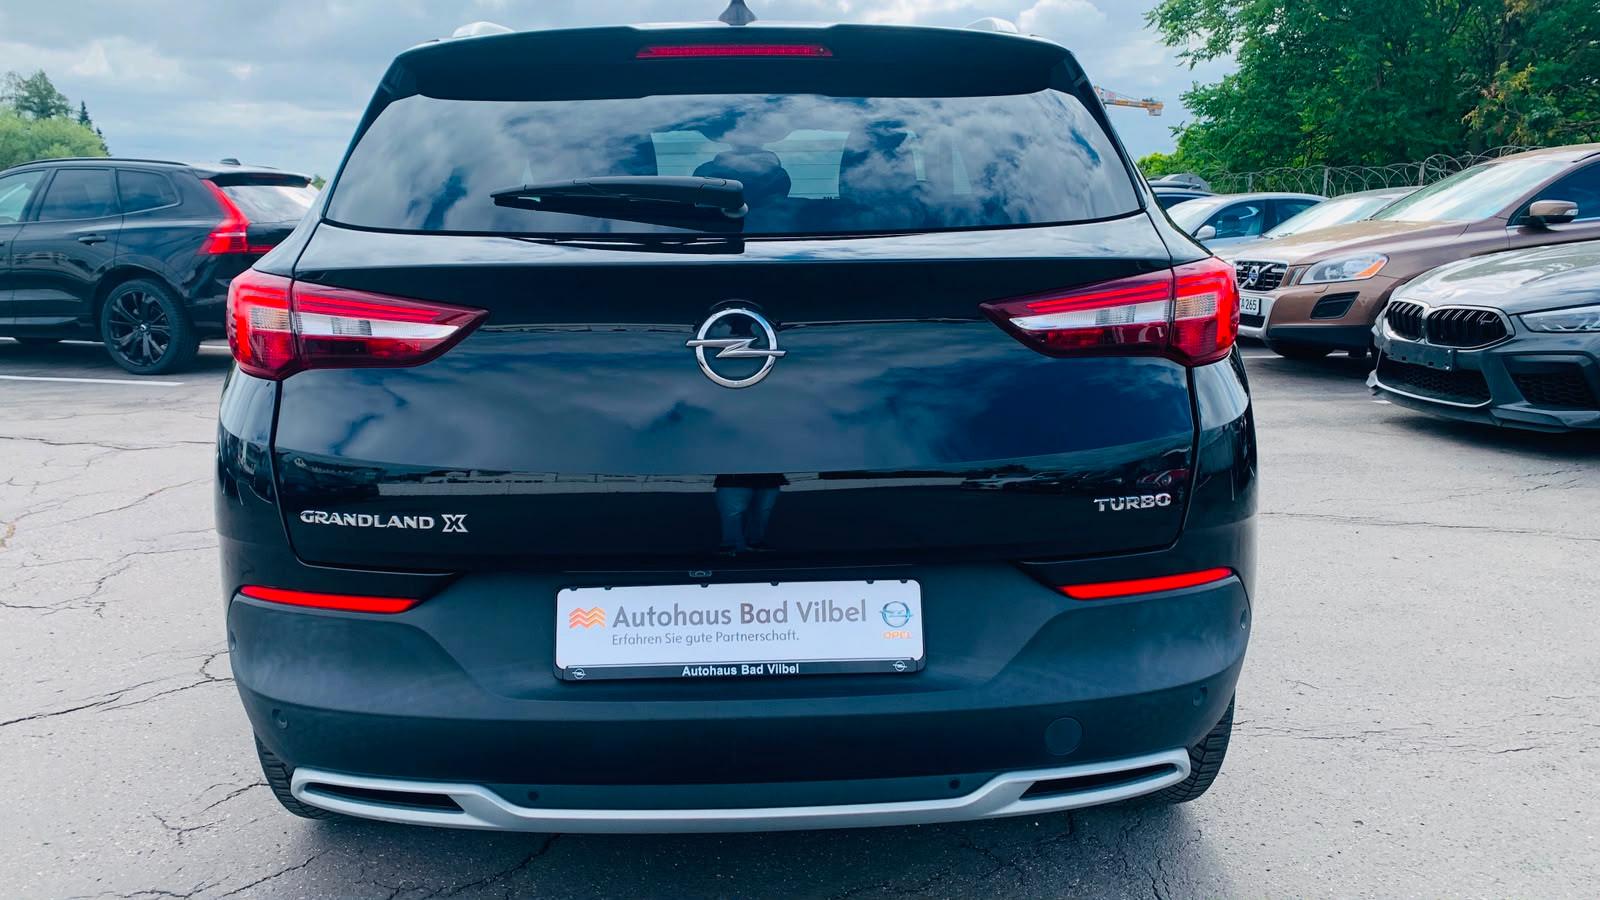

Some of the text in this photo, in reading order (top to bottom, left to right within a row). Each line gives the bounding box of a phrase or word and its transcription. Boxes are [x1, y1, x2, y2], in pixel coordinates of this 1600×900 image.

[1245, 298, 1257, 311] 265
[1093, 493, 1172, 512] TURBO
[300, 510, 468, 533] GRANDLAND X
[612, 598, 867, 628] Autohaus Bad Vilbel
[612, 629, 800, 647] Erfahren Sie gute Partnerschaft.
[883, 631, 912, 640] OPEL
[681, 662, 800, 677] Autohaus Bad Vilbel
